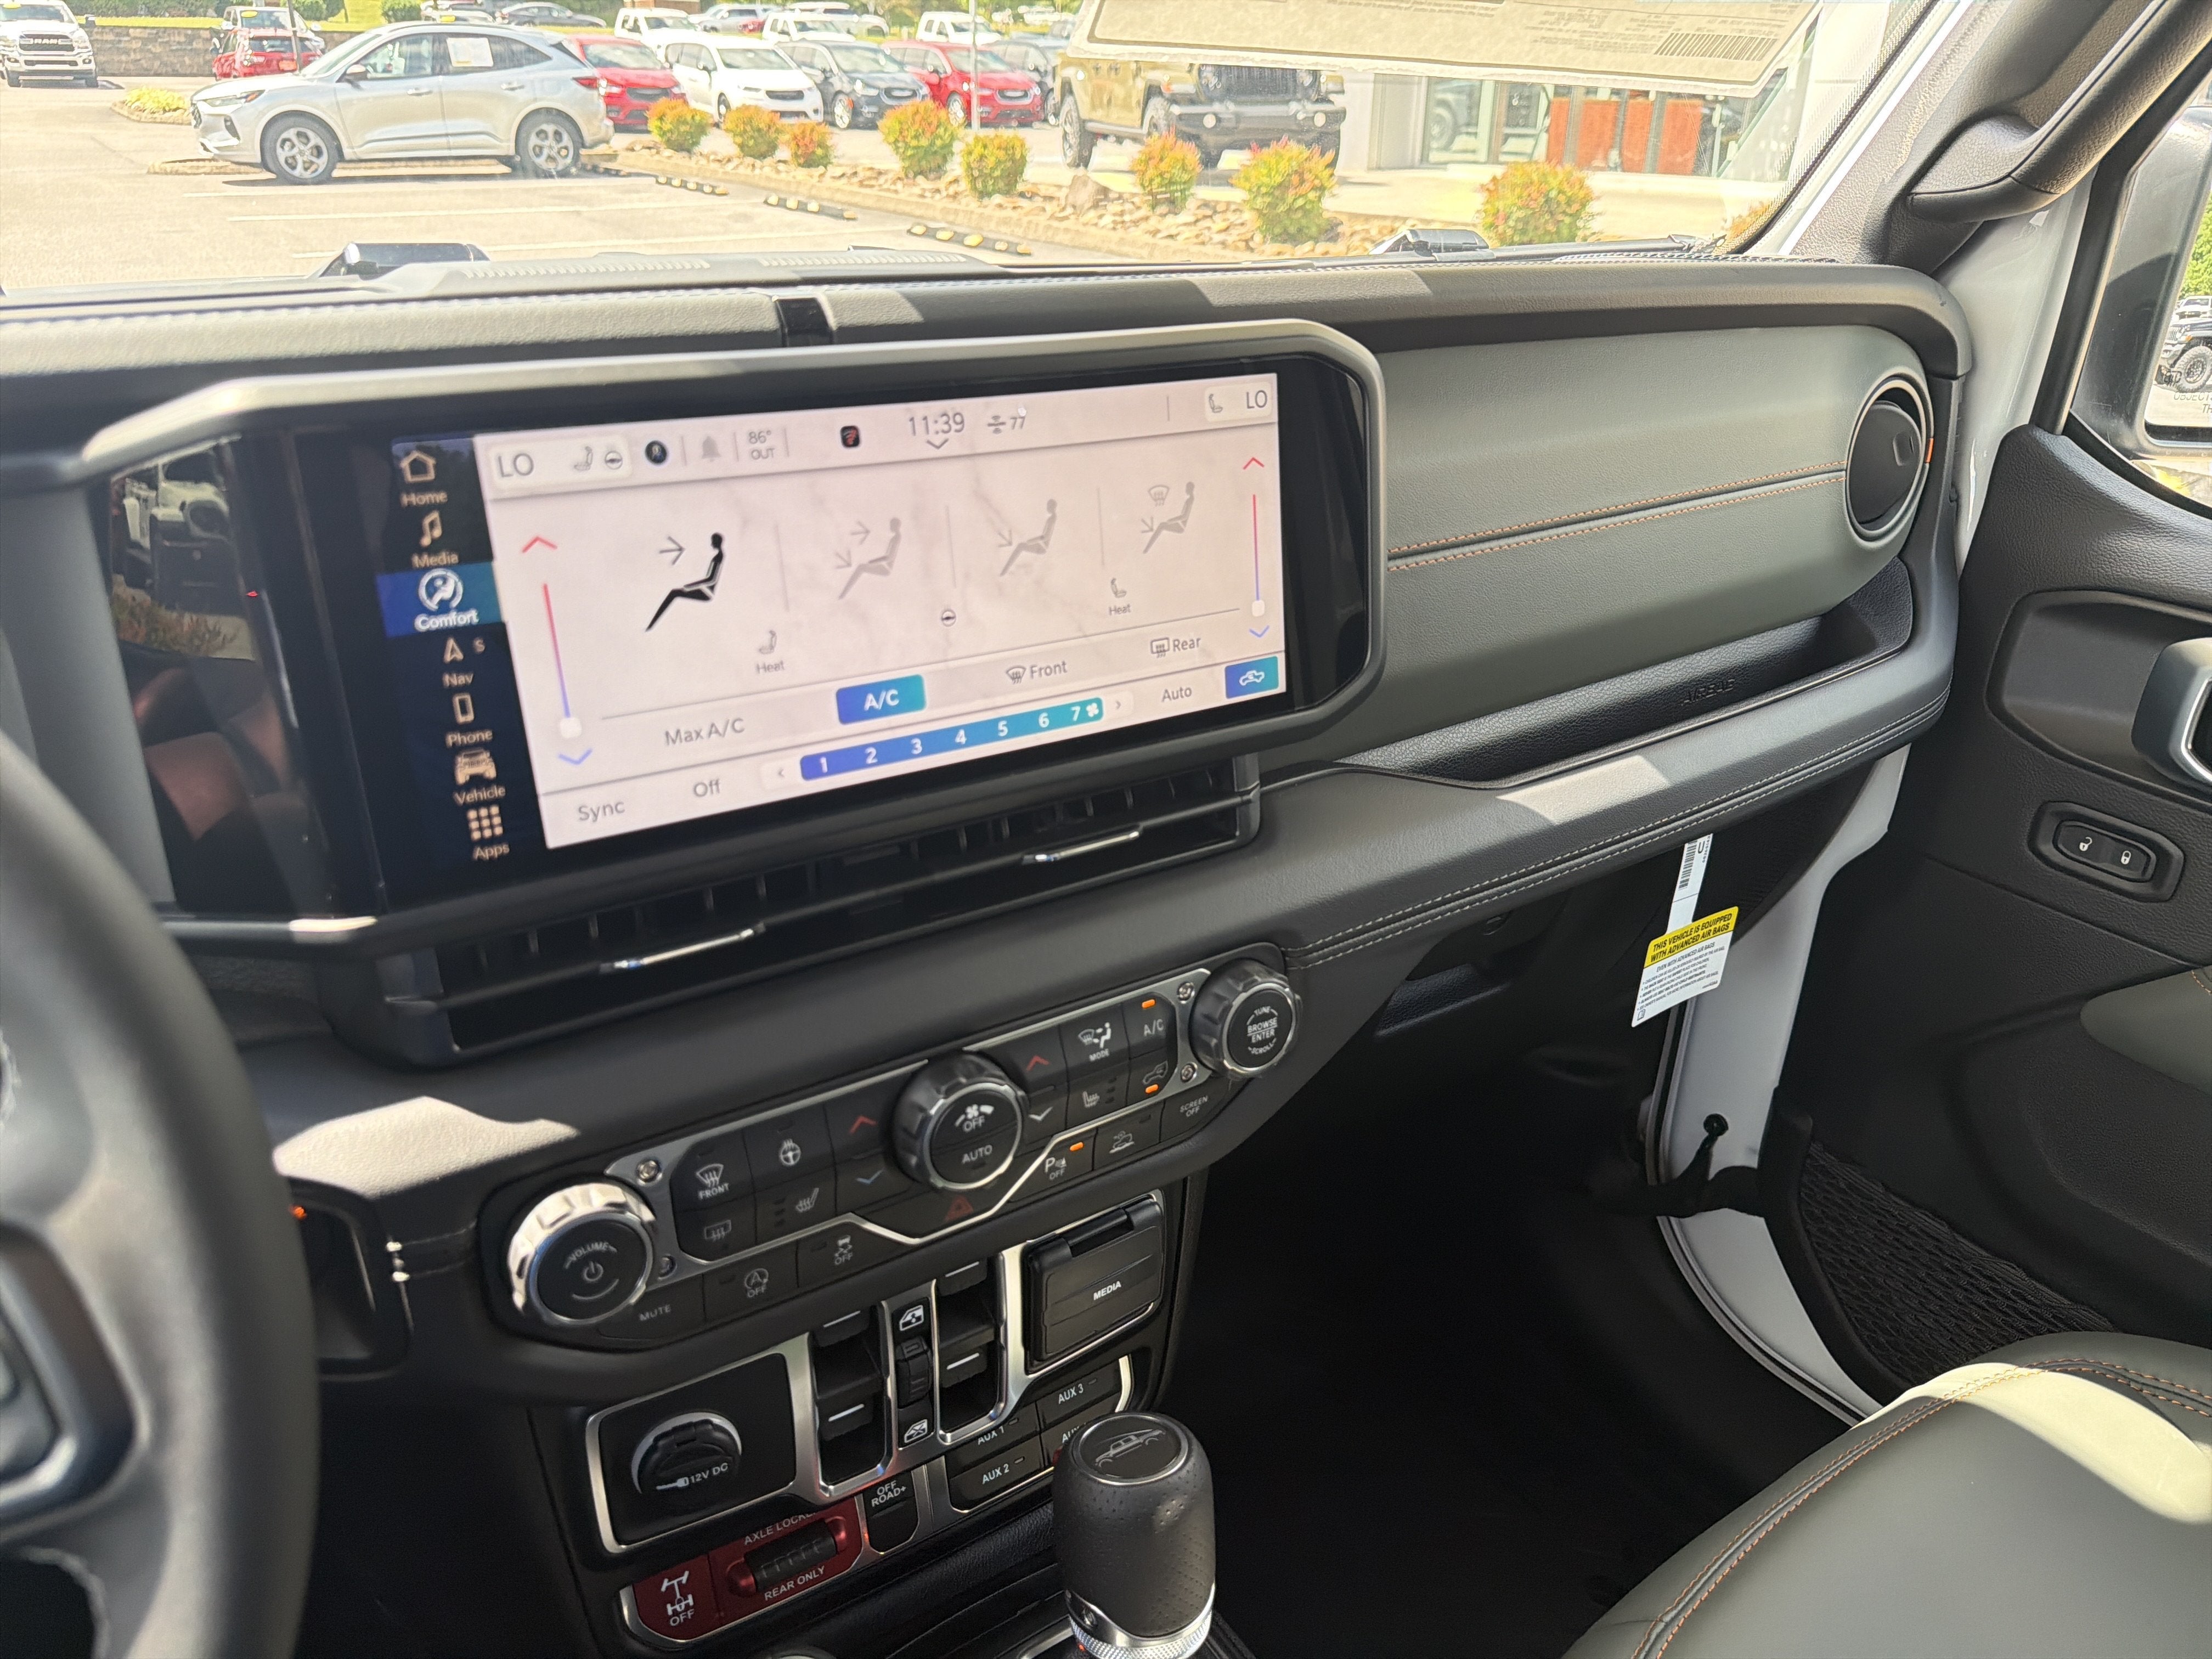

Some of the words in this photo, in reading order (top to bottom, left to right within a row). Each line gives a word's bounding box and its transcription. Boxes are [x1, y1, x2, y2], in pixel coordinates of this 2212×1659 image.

[1246, 390, 1267, 409] LO
[909, 412, 965, 436] 11:39
[1010, 416, 1025, 430] 77
[751, 447, 775, 460] OUT
[498, 453, 534, 477] LO
[400, 490, 448, 507] Home
[412, 551, 459, 568] Media
[1108, 603, 1131, 616] Heat
[414, 608, 479, 631] Comfort
[1172, 635, 1201, 652] Rear
[755, 660, 785, 674] Heat
[1029, 660, 1068, 680] Front
[443, 672, 473, 687] Nav
[864, 689, 900, 712] A/C
[1161, 686, 1192, 703] Auto
[446, 730, 493, 747] Phone
[665, 727, 702, 746] Max
[708, 718, 746, 739] A/C
[820, 757, 828, 773] 1
[865, 747, 878, 764] 2
[911, 738, 923, 754] 3
[955, 729, 967, 745] 4
[997, 720, 1008, 737] 5
[1039, 712, 1049, 729] 6
[1070, 706, 1081, 721] 7
[454, 785, 506, 805] Vehicle
[693, 778, 721, 798] Off
[578, 800, 625, 822] Sync
[473, 843, 510, 861] Apps
[1653, 939, 1667, 952] THIS
[1668, 929, 1694, 945] VEHICLE
[1694, 924, 1700, 933] IS
[1701, 913, 1732, 930] EQUIPPED
[1651, 949, 1666, 962] WITH
[1667, 935, 1700, 955] ADVANCED
[1701, 929, 1711, 939] AIR
[1713, 923, 1730, 935] BAGS
[1254, 1006, 1271, 1016] TUNE
[1143, 1018, 1164, 1037] A/C
[1248, 1017, 1277, 1034] BROWSE
[1251, 1029, 1274, 1043] ENTER
[1089, 1048, 1110, 1062] MODE
[1251, 1042, 1274, 1054] SCROLL
[1180, 1094, 1209, 1113] SCREEN
[1185, 1105, 1201, 1118] OFF
[963, 1116, 985, 1133] OFF
[961, 1144, 993, 1164] AUTO
[1049, 1169, 1065, 1181] OFF
[698, 1182, 729, 1200] FRONT
[569, 1242, 610, 1263] VOLUME
[834, 1252, 853, 1265] OFF
[747, 1286, 766, 1299] OFF
[1093, 1280, 1122, 1301] MEDIA
[639, 1304, 672, 1322] MUTE
[1058, 1386, 1077, 1404] AUX
[1077, 1383, 1085, 1394] 3
[978, 1431, 997, 1446] AUX
[998, 1425, 1005, 1434] 1
[689, 1469, 709, 1485] 12V
[713, 1463, 729, 1478] DC
[982, 1467, 1002, 1485] AUX
[1001, 1463, 1011, 1476] 2
[871, 1485, 907, 1507] ROAD+
[876, 1480, 897, 1496] OFF
[744, 1525, 774, 1545] AXLE
[764, 1581, 795, 1601] REAR
[797, 1565, 825, 1585] ONLY
[669, 1609, 695, 1627] OFF
